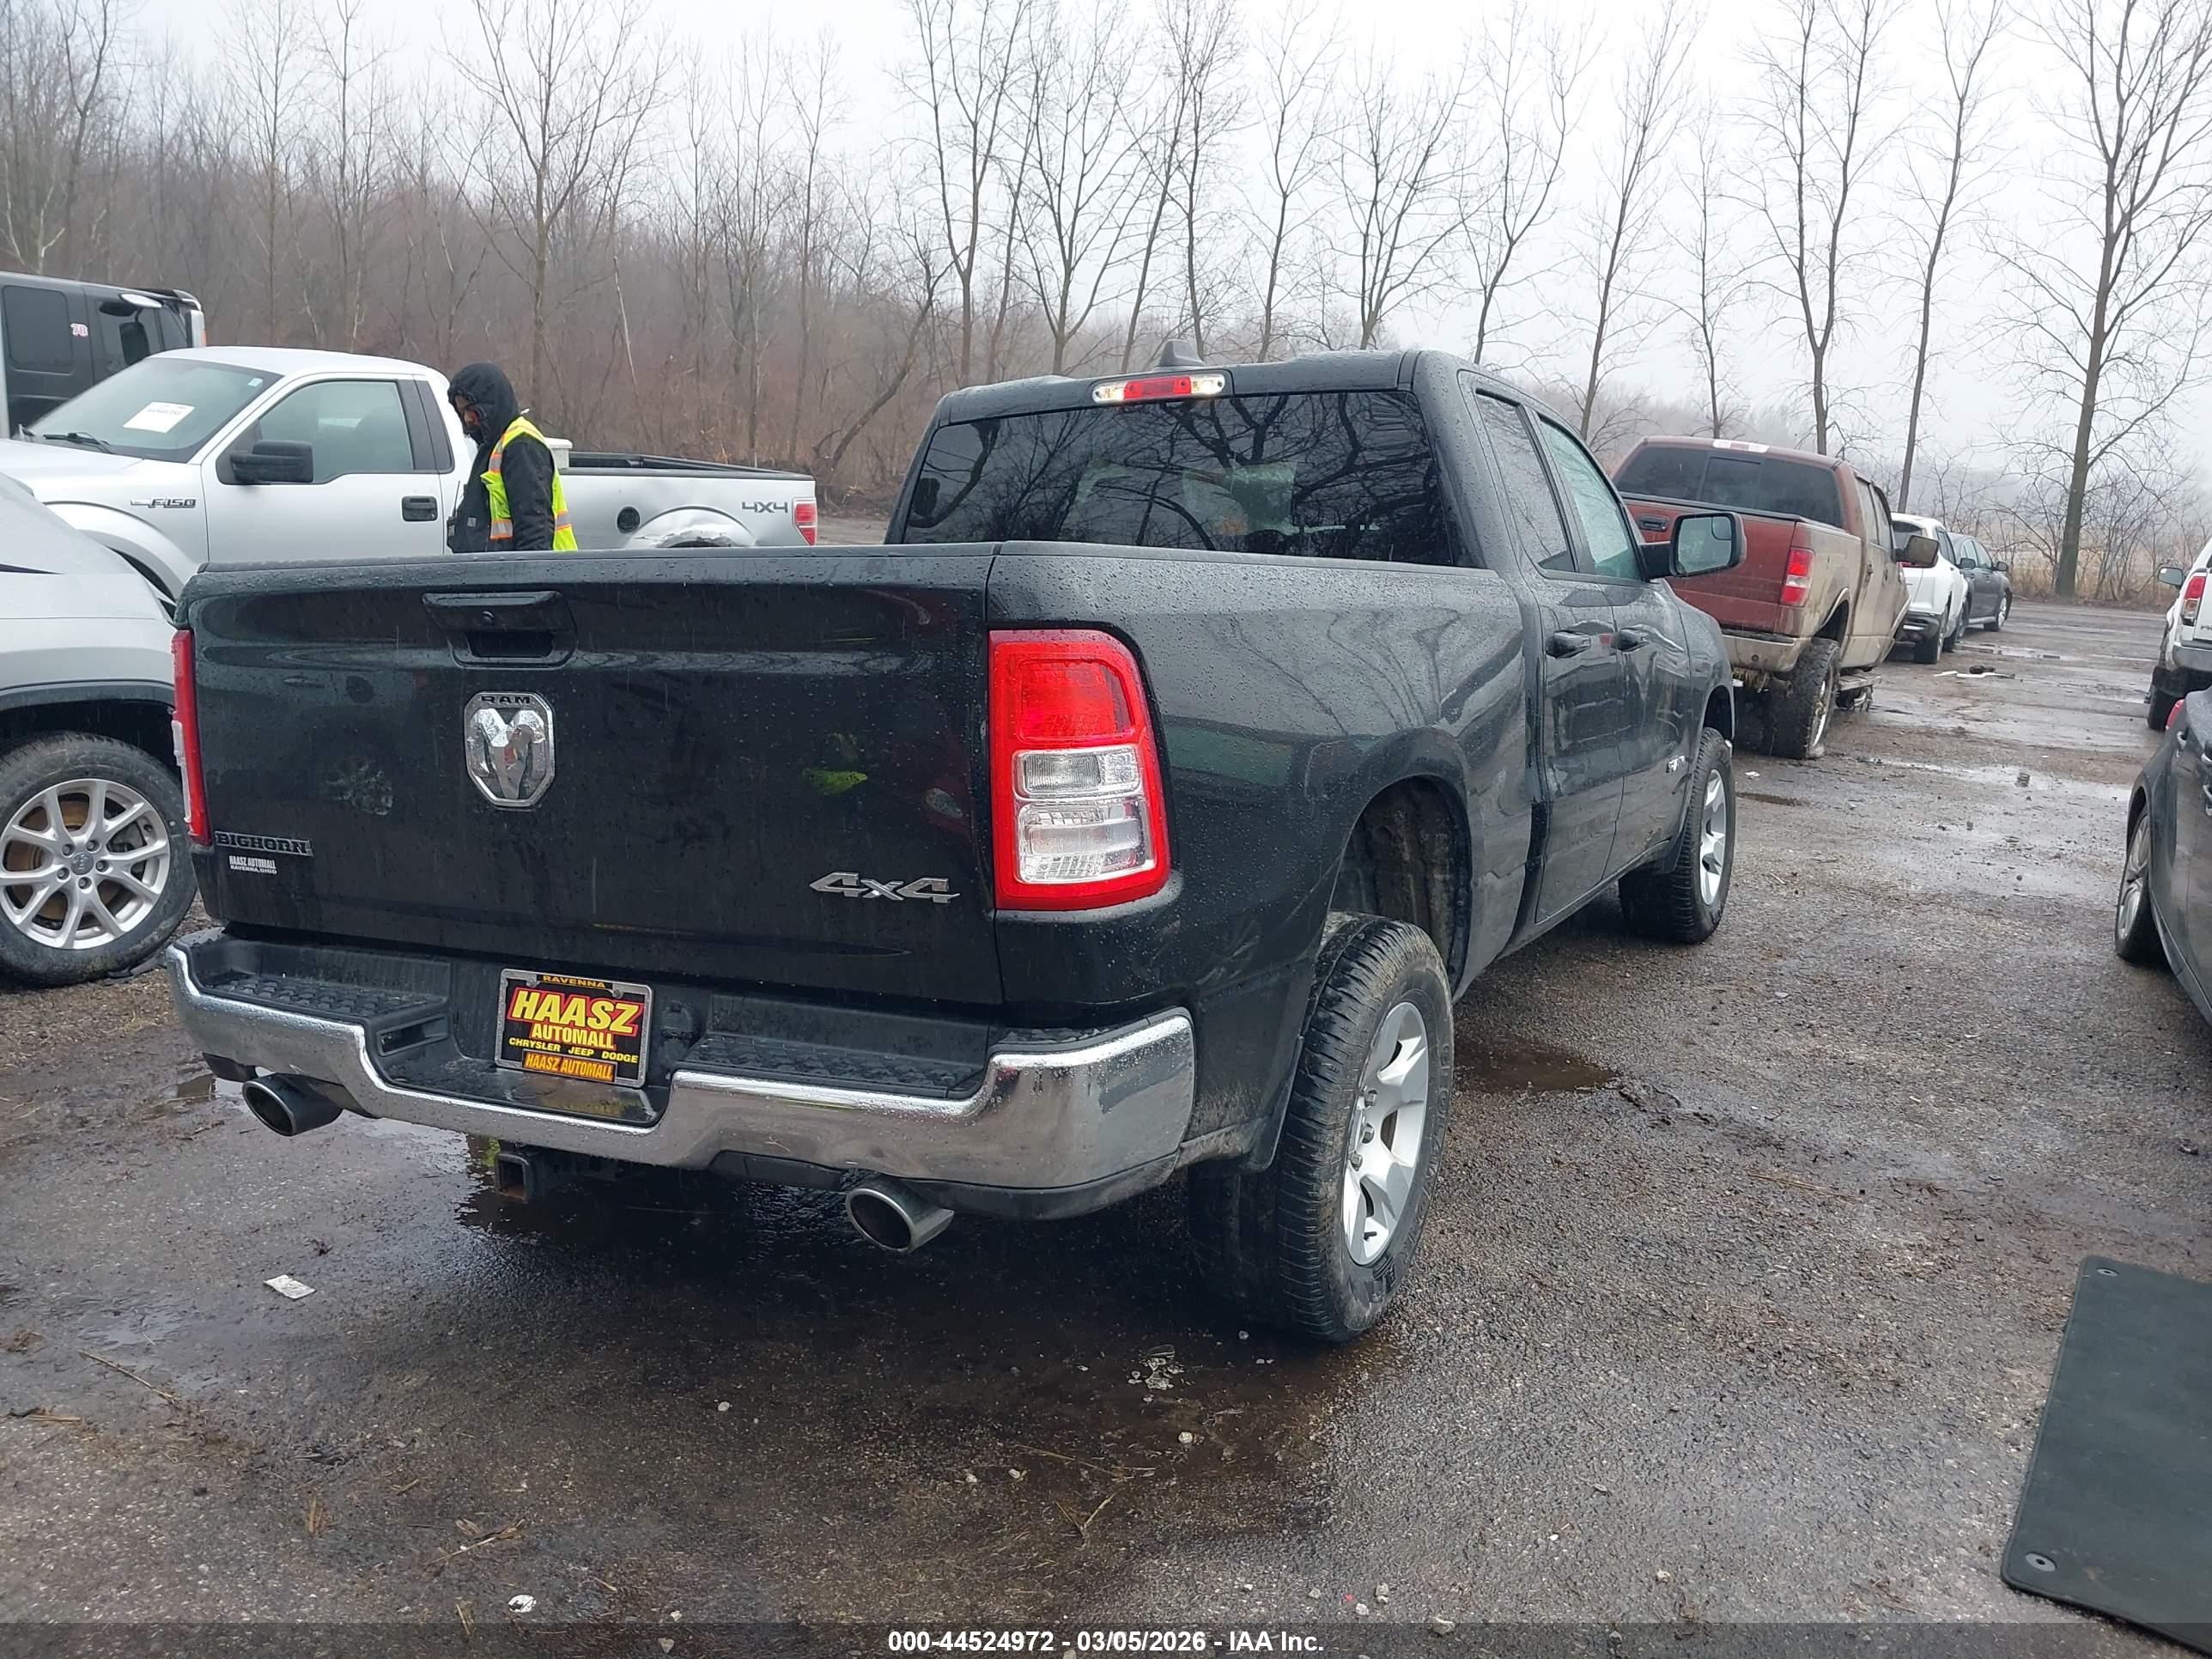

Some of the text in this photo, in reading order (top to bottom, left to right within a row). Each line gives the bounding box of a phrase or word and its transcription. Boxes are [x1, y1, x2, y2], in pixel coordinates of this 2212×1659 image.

[481, 696, 531, 704] RAM
[228, 855, 276, 869] HAASZ AUTOMALL
[543, 975, 606, 988] RAVENNA
[510, 989, 641, 1035] HAASZ
[531, 1023, 615, 1049] AUTOMALL
[508, 1036, 639, 1064] CHRYSLER JEEP DODGE
[526, 1053, 614, 1079] HAASZ AUTOMALL
